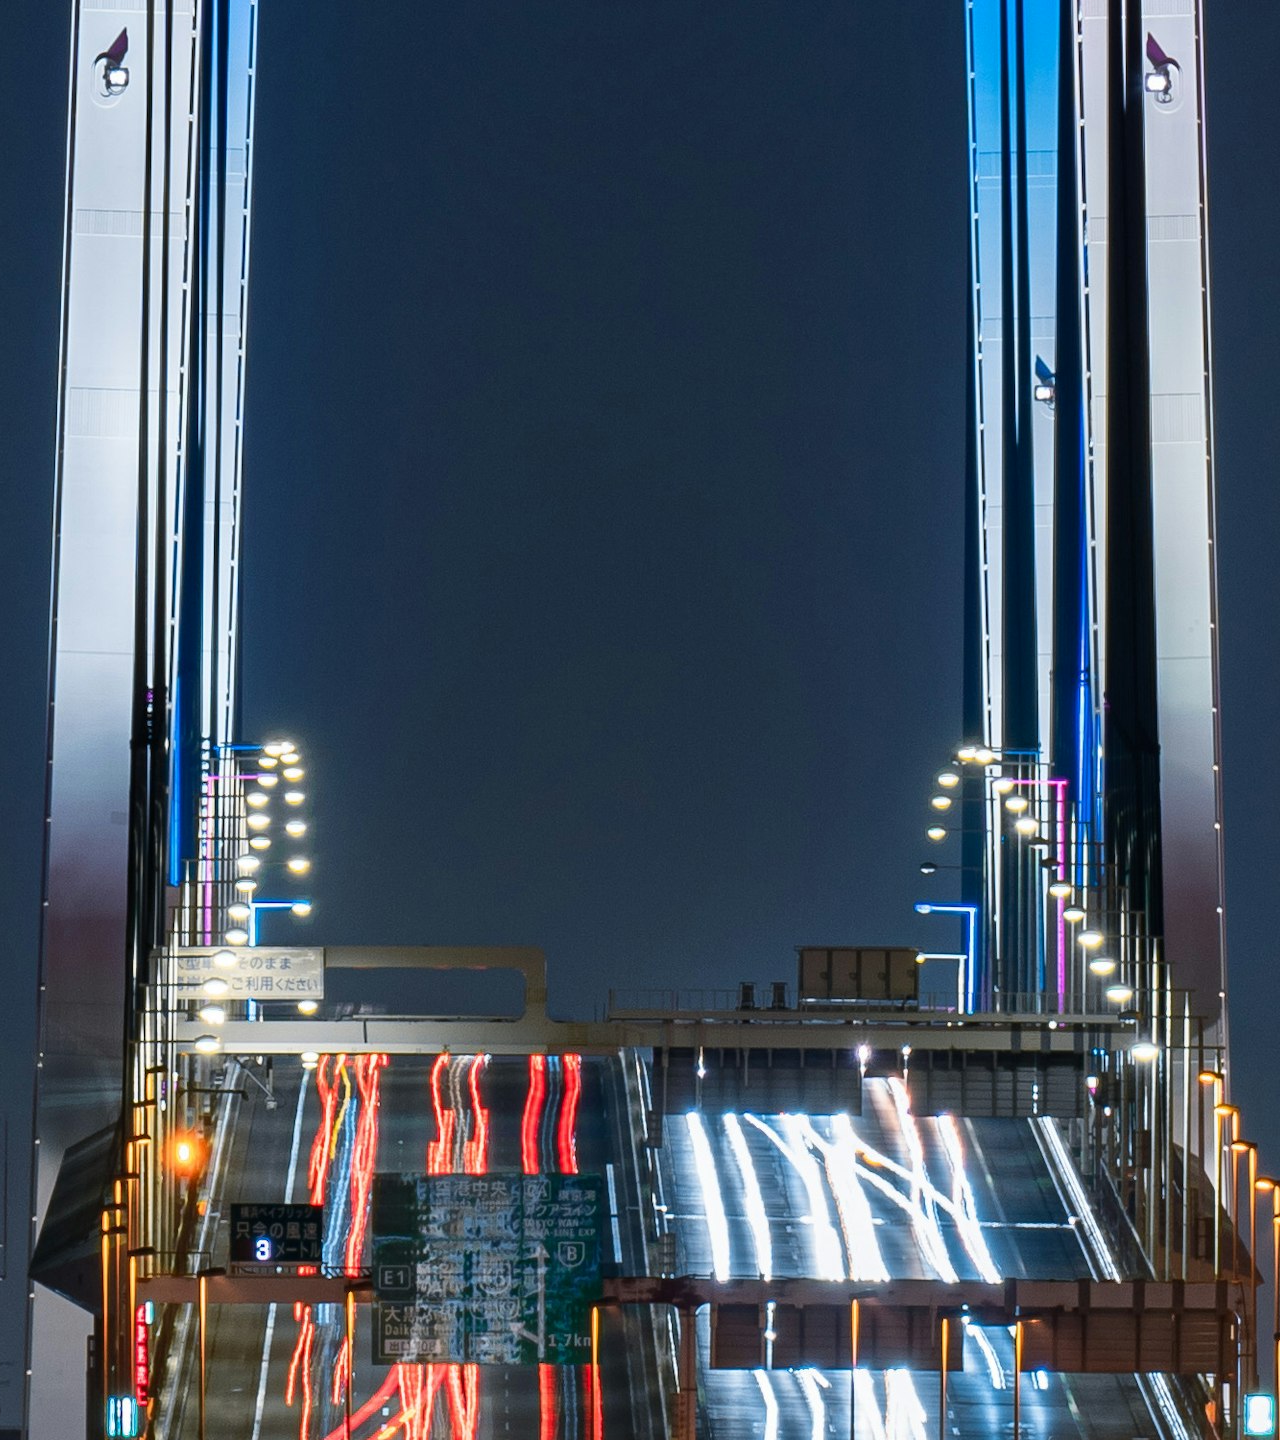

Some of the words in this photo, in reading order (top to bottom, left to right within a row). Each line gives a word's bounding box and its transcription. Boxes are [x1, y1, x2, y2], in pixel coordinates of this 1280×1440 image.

[434, 1180, 507, 1197] 空港中央
[236, 1221, 317, 1239] 只今の風速
[256, 1239, 271, 1261] 3
[275, 1241, 320, 1258] メートル
[567, 1245, 577, 1261] B
[384, 1270, 404, 1285] E1
